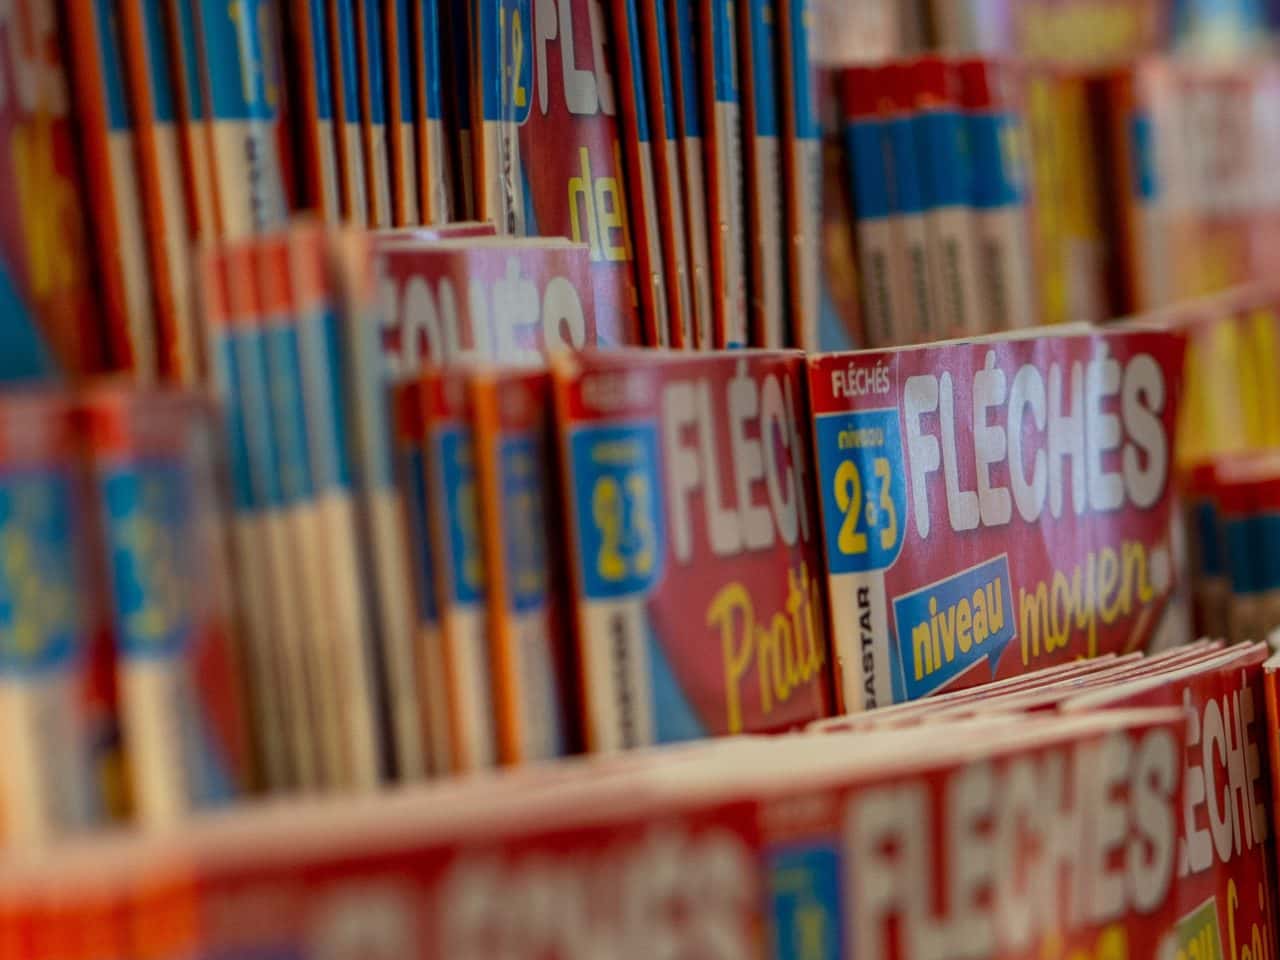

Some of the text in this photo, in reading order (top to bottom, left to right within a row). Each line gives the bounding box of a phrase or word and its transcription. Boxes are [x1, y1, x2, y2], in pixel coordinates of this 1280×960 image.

[663, 358, 809, 564] FLÉC
[831, 359, 890, 398] FLÉCHÉS
[903, 339, 1168, 540] FLÉCHÉS
[912, 537, 1153, 681] niveau moyen
[1178, 669, 1268, 876] ÉCHÉ
